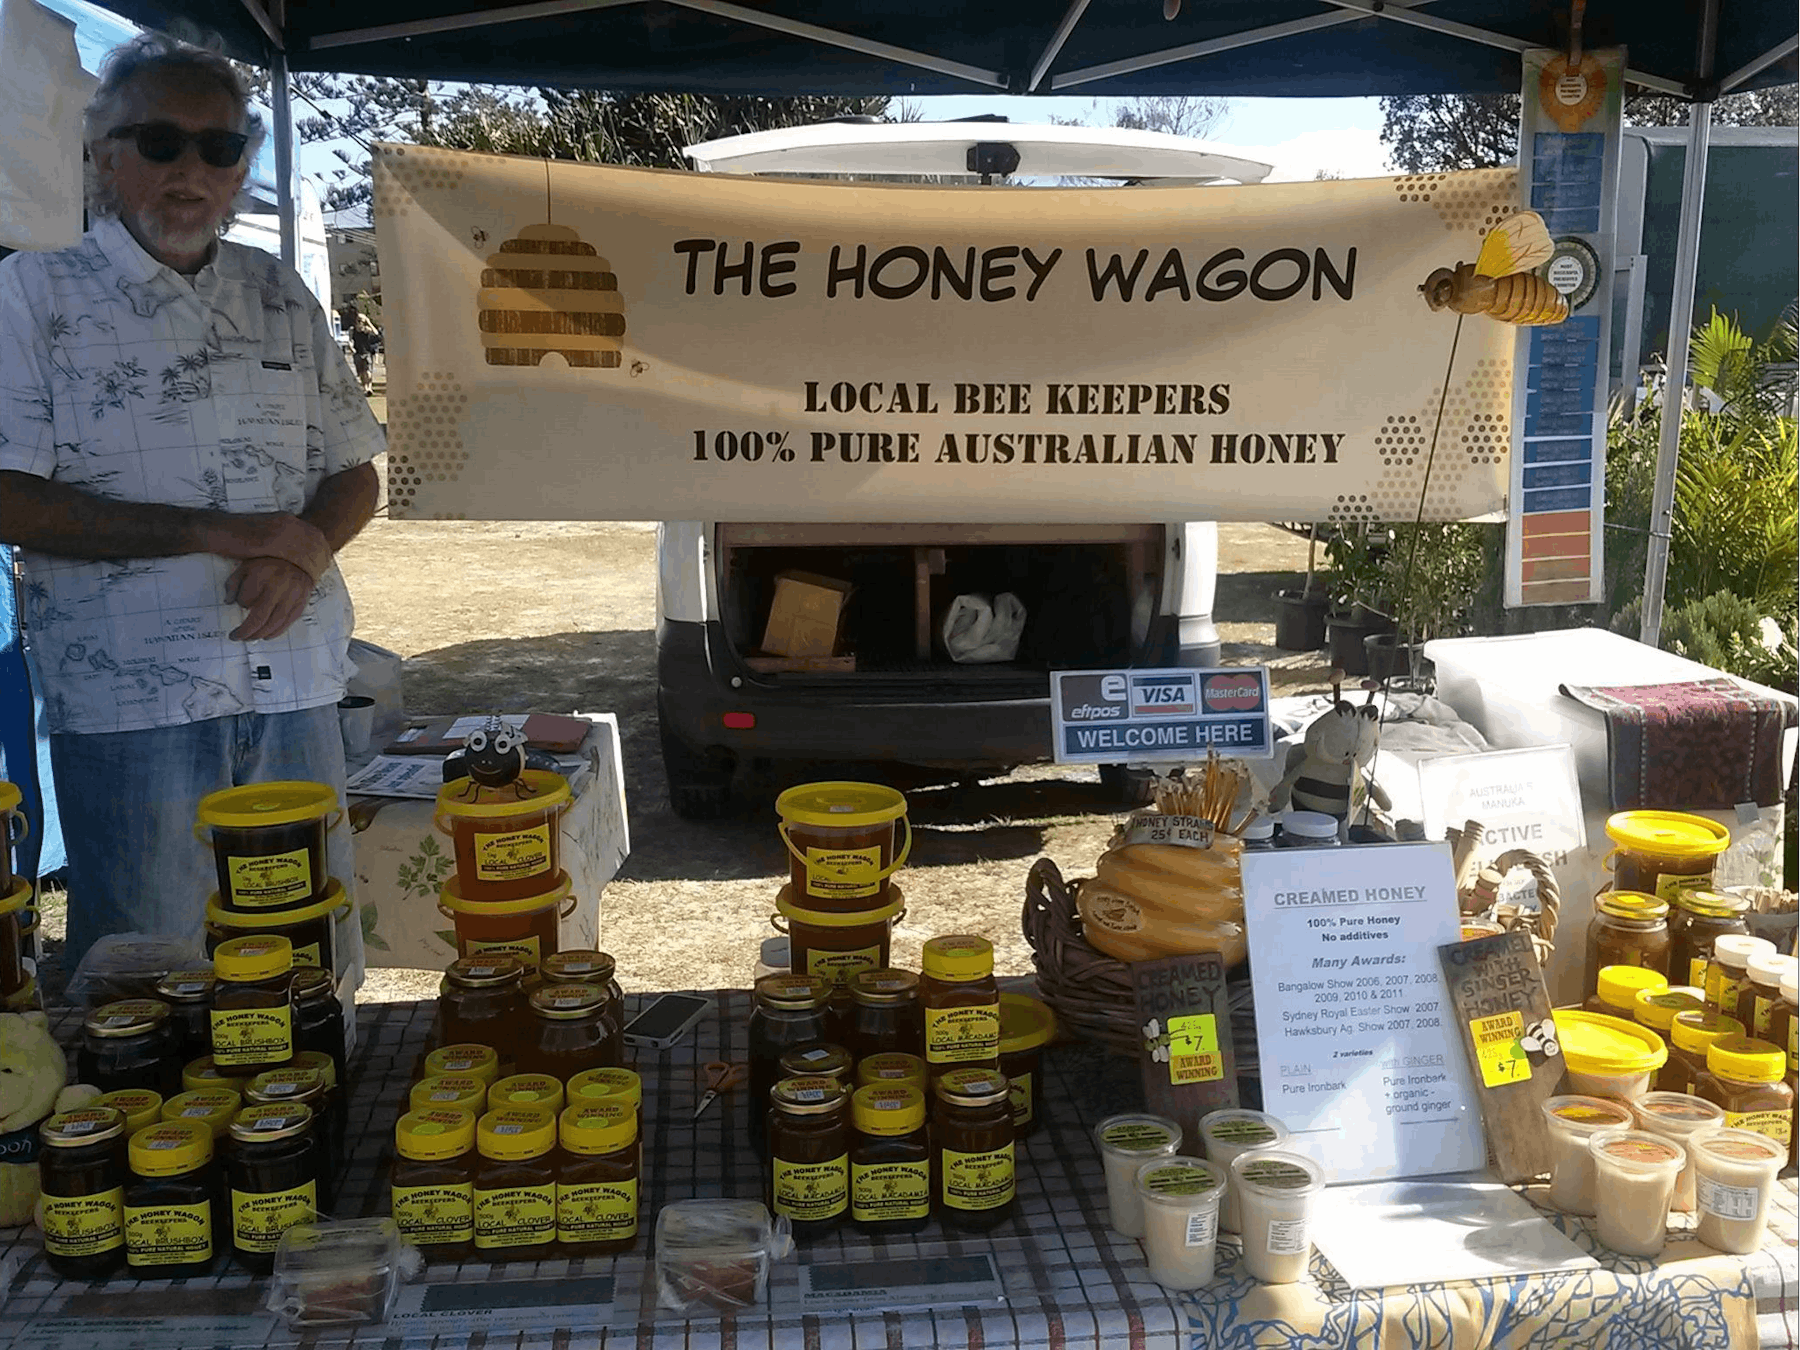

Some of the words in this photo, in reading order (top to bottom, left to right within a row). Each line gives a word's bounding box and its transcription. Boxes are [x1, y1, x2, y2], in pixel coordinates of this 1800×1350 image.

[674, 239, 801, 298] THE
[827, 244, 1062, 302] HONEY
[1086, 247, 1357, 301] WAGON
[803, 381, 940, 414] LOCAL
[953, 383, 1032, 415] BEE
[1045, 383, 1231, 415] KEEPERS
[692, 429, 797, 463] 100%
[809, 431, 921, 463] PURE
[933, 432, 1198, 464] AUSTRALIAN
[1209, 433, 1346, 464] HONEY
[1142, 687, 1185, 703] VISA
[1205, 686, 1259, 699] MasterCard
[1071, 704, 1121, 720] eftpos
[1077, 727, 1189, 748] WELCOME
[1196, 724, 1253, 743] HERE
[1132, 816, 1168, 828] HONEY
[1178, 829, 1208, 843] EACH
[236, 862, 248, 874] THE
[249, 858, 274, 866] HONEY
[276, 858, 302, 868] WAGON
[1274, 888, 1358, 906] CREAMED
[1365, 886, 1426, 901] HONEY
[1307, 918, 1337, 928] 100%
[1339, 917, 1363, 926] Pure
[1368, 916, 1400, 925] Honey
[1322, 933, 1337, 942] No
[1339, 931, 1388, 940] additives
[1312, 957, 1347, 969] Many
[1351, 954, 1406, 966] Awards:
[1472, 957, 1521, 976] WITH
[1139, 960, 1220, 989] CREAMED
[1278, 980, 1324, 992] Bangalow
[1327, 978, 1353, 989] Show
[1140, 985, 1221, 1013] HONEY
[1344, 990, 1368, 1001] 2010
[1370, 990, 1378, 999] &
[1380, 989, 1403, 998] 2011
[947, 1016, 988, 1024] BEEKEEPERS
[1282, 1010, 1318, 1022] Sydney
[1321, 1008, 1347, 1019] Royal
[1351, 1007, 1380, 1016] Easter
[1384, 1005, 1409, 1014] Show
[213, 1019, 225, 1030] THE
[226, 1013, 255, 1022] HONEY
[257, 1014, 285, 1028] WAGON
[1481, 1016, 1513, 1032] AWARD
[1285, 1026, 1337, 1038] Hawksbury
[1359, 1022, 1385, 1032] Show
[1479, 1027, 1521, 1043] WINNING
[1180, 1054, 1212, 1068] AWARD
[1381, 1057, 1399, 1068] with
[1403, 1055, 1444, 1066] GINGER
[1176, 1066, 1218, 1080] WINNING
[1280, 1065, 1311, 1075] PLAIN
[1383, 1076, 1405, 1086] Pure
[1408, 1074, 1446, 1084] Ironbark
[1283, 1084, 1305, 1094] Pure
[1308, 1081, 1347, 1092] Ironbark
[1393, 1089, 1428, 1100] organic
[1386, 1103, 1418, 1115] ground
[1422, 1101, 1452, 1112] ginger
[950, 1159, 963, 1170] THE
[964, 1154, 992, 1164] HONEY
[964, 1161, 1004, 1169] BEEKEEPERS
[780, 1167, 792, 1180] THE
[793, 1166, 822, 1175] HONEY
[823, 1165, 844, 1176] WAGON
[793, 1172, 835, 1181] BEEKEEPERS
[855, 1171, 870, 1184] THE
[870, 1166, 899, 1176] HONEY
[900, 1166, 927, 1182] WAGON
[395, 1191, 411, 1209] THE
[411, 1189, 441, 1199] HONEY
[442, 1190, 472, 1204] WAGON
[557, 1192, 573, 1205] THE
[574, 1187, 600, 1197] HONEY
[602, 1187, 631, 1203] WAGON
[778, 1189, 801, 1199] LOCAL
[803, 1186, 845, 1199] MACADAMIA
[855, 1192, 877, 1201] LOCAL
[880, 1190, 927, 1200] MACADAMIA
[86, 1201, 116, 1212] WAGON
[238, 1201, 250, 1213] THE
[252, 1196, 282, 1206] HONEY
[285, 1195, 311, 1205] WAGON
[252, 1201, 297, 1212] BEEKEEPERS
[476, 1195, 491, 1211] THE
[491, 1192, 521, 1201] HONEY
[523, 1190, 553, 1205] WAGON
[125, 1217, 138, 1228] THE
[140, 1210, 171, 1219] HONEY
[174, 1210, 205, 1225] WAGON
[397, 1217, 424, 1226] LOCAL
[436, 1215, 471, 1224] CLOVER
[478, 1219, 505, 1229] LOCAL
[517, 1216, 551, 1225] CLOVER
[558, 1215, 585, 1224] LOCAL
[595, 1212, 629, 1221] CLOVER
[67, 1221, 116, 1236] BRUSHBOX
[156, 1235, 204, 1245] BRUSHBOX
